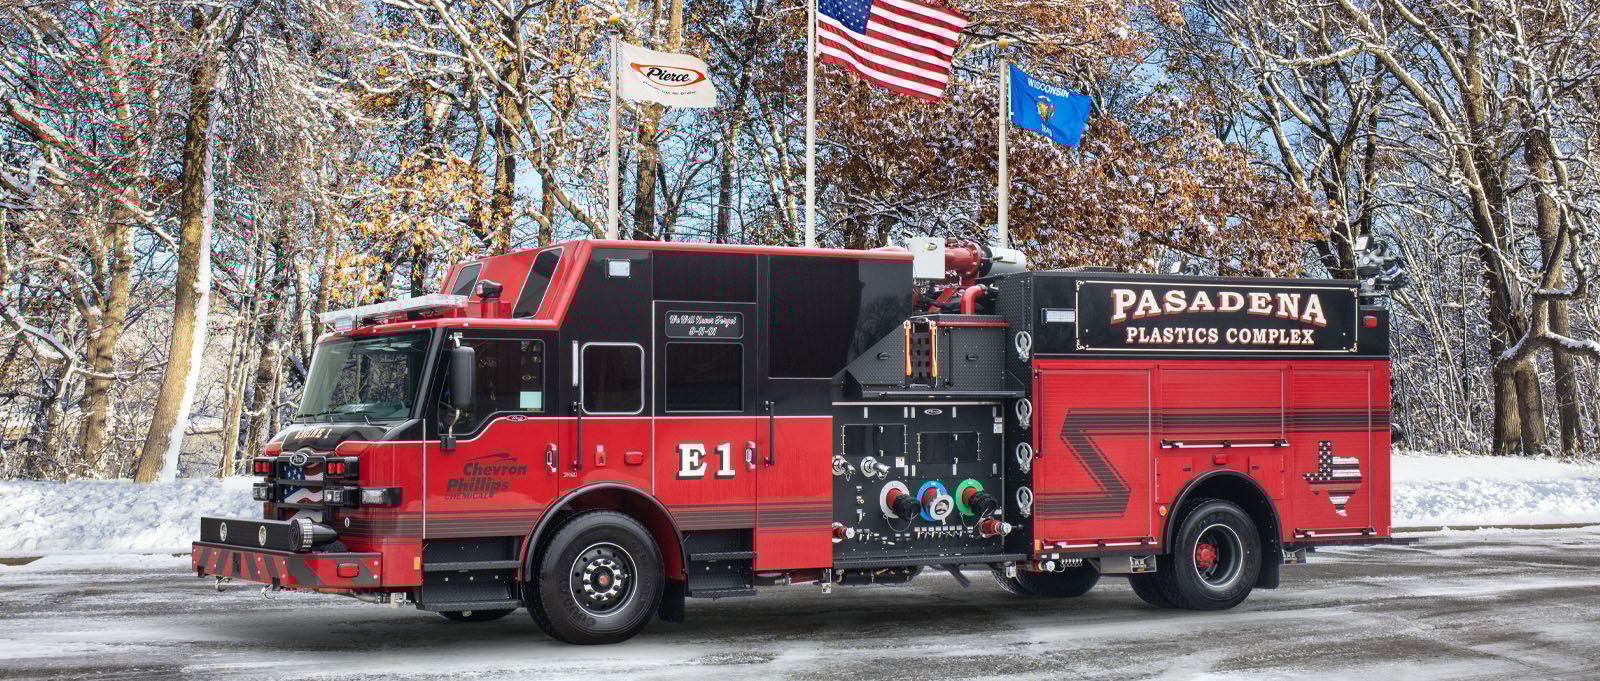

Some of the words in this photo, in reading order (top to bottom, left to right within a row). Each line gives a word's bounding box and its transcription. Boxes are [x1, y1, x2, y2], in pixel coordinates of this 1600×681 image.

[646, 67, 689, 82] Pierce
[1027, 77, 1070, 98] WISCONSIN
[1110, 288, 1327, 327] PASADENA
[1126, 326, 1219, 344] PLASTICS
[1226, 328, 1315, 345] COMPLEX
[464, 462, 527, 476] Chevron
[676, 442, 736, 480] E1
[445, 487, 490, 500] CHEMICAL
[447, 477, 509, 498] Phillips
